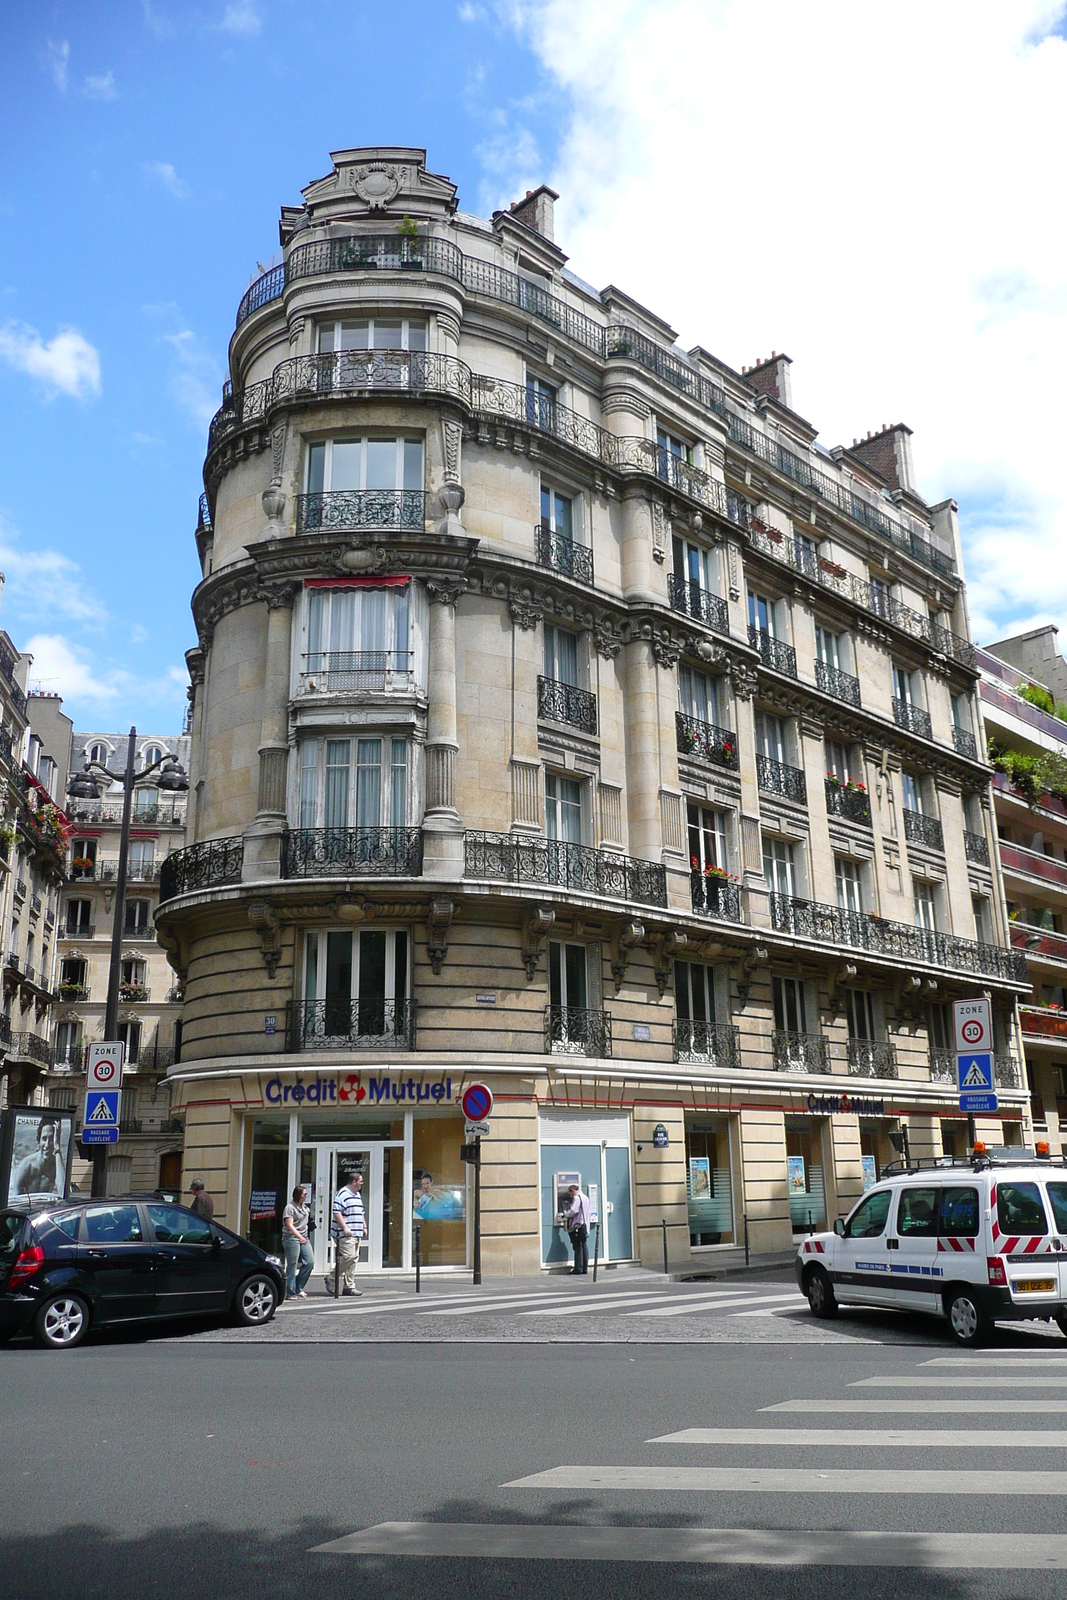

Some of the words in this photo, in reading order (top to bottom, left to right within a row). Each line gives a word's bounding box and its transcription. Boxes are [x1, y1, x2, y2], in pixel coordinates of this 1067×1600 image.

[960, 1006, 983, 1014] ZONE
[265, 1016, 275, 1025] 30
[966, 1027, 979, 1036] 30
[98, 1067, 110, 1075] 30
[265, 1078, 337, 1103] Crédit
[369, 1077, 452, 1100] Mutuel
[807, 1093, 840, 1114] Crédit
[851, 1096, 884, 1114] Mutuel
[966, 1102, 990, 1110] SURÉLEVÉ
[17, 1118, 41, 1126] CHANEL
[340, 1157, 363, 1165] Ouvert
[344, 1165, 367, 1173] samedi
